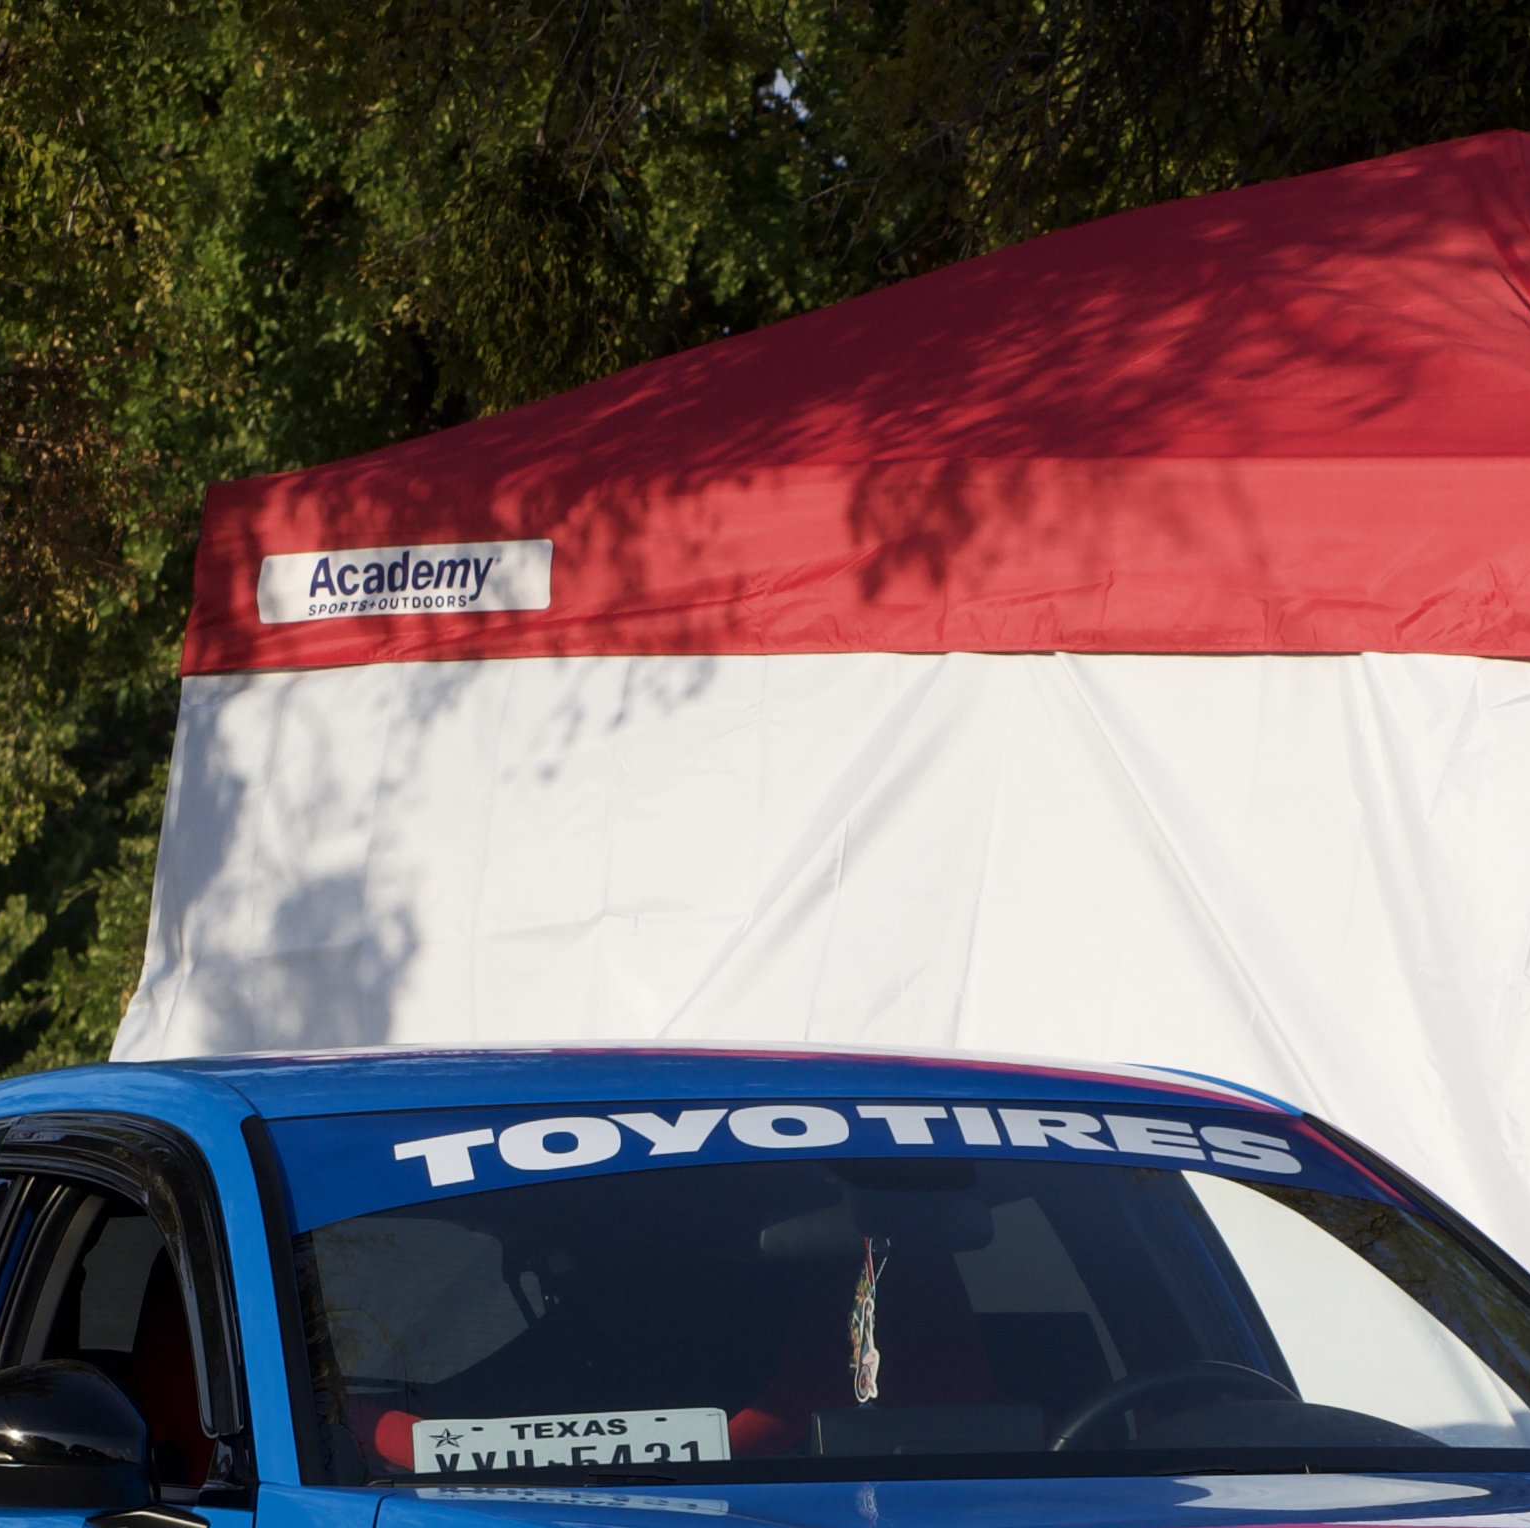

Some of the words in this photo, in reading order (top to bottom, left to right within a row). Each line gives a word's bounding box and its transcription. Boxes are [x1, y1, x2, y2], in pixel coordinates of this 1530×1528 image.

[309, 550, 494, 601] Academy
[394, 1105, 852, 1188] TOYO
[856, 1105, 1303, 1175] TIRES
[510, 1418, 628, 1440] TEXAS
